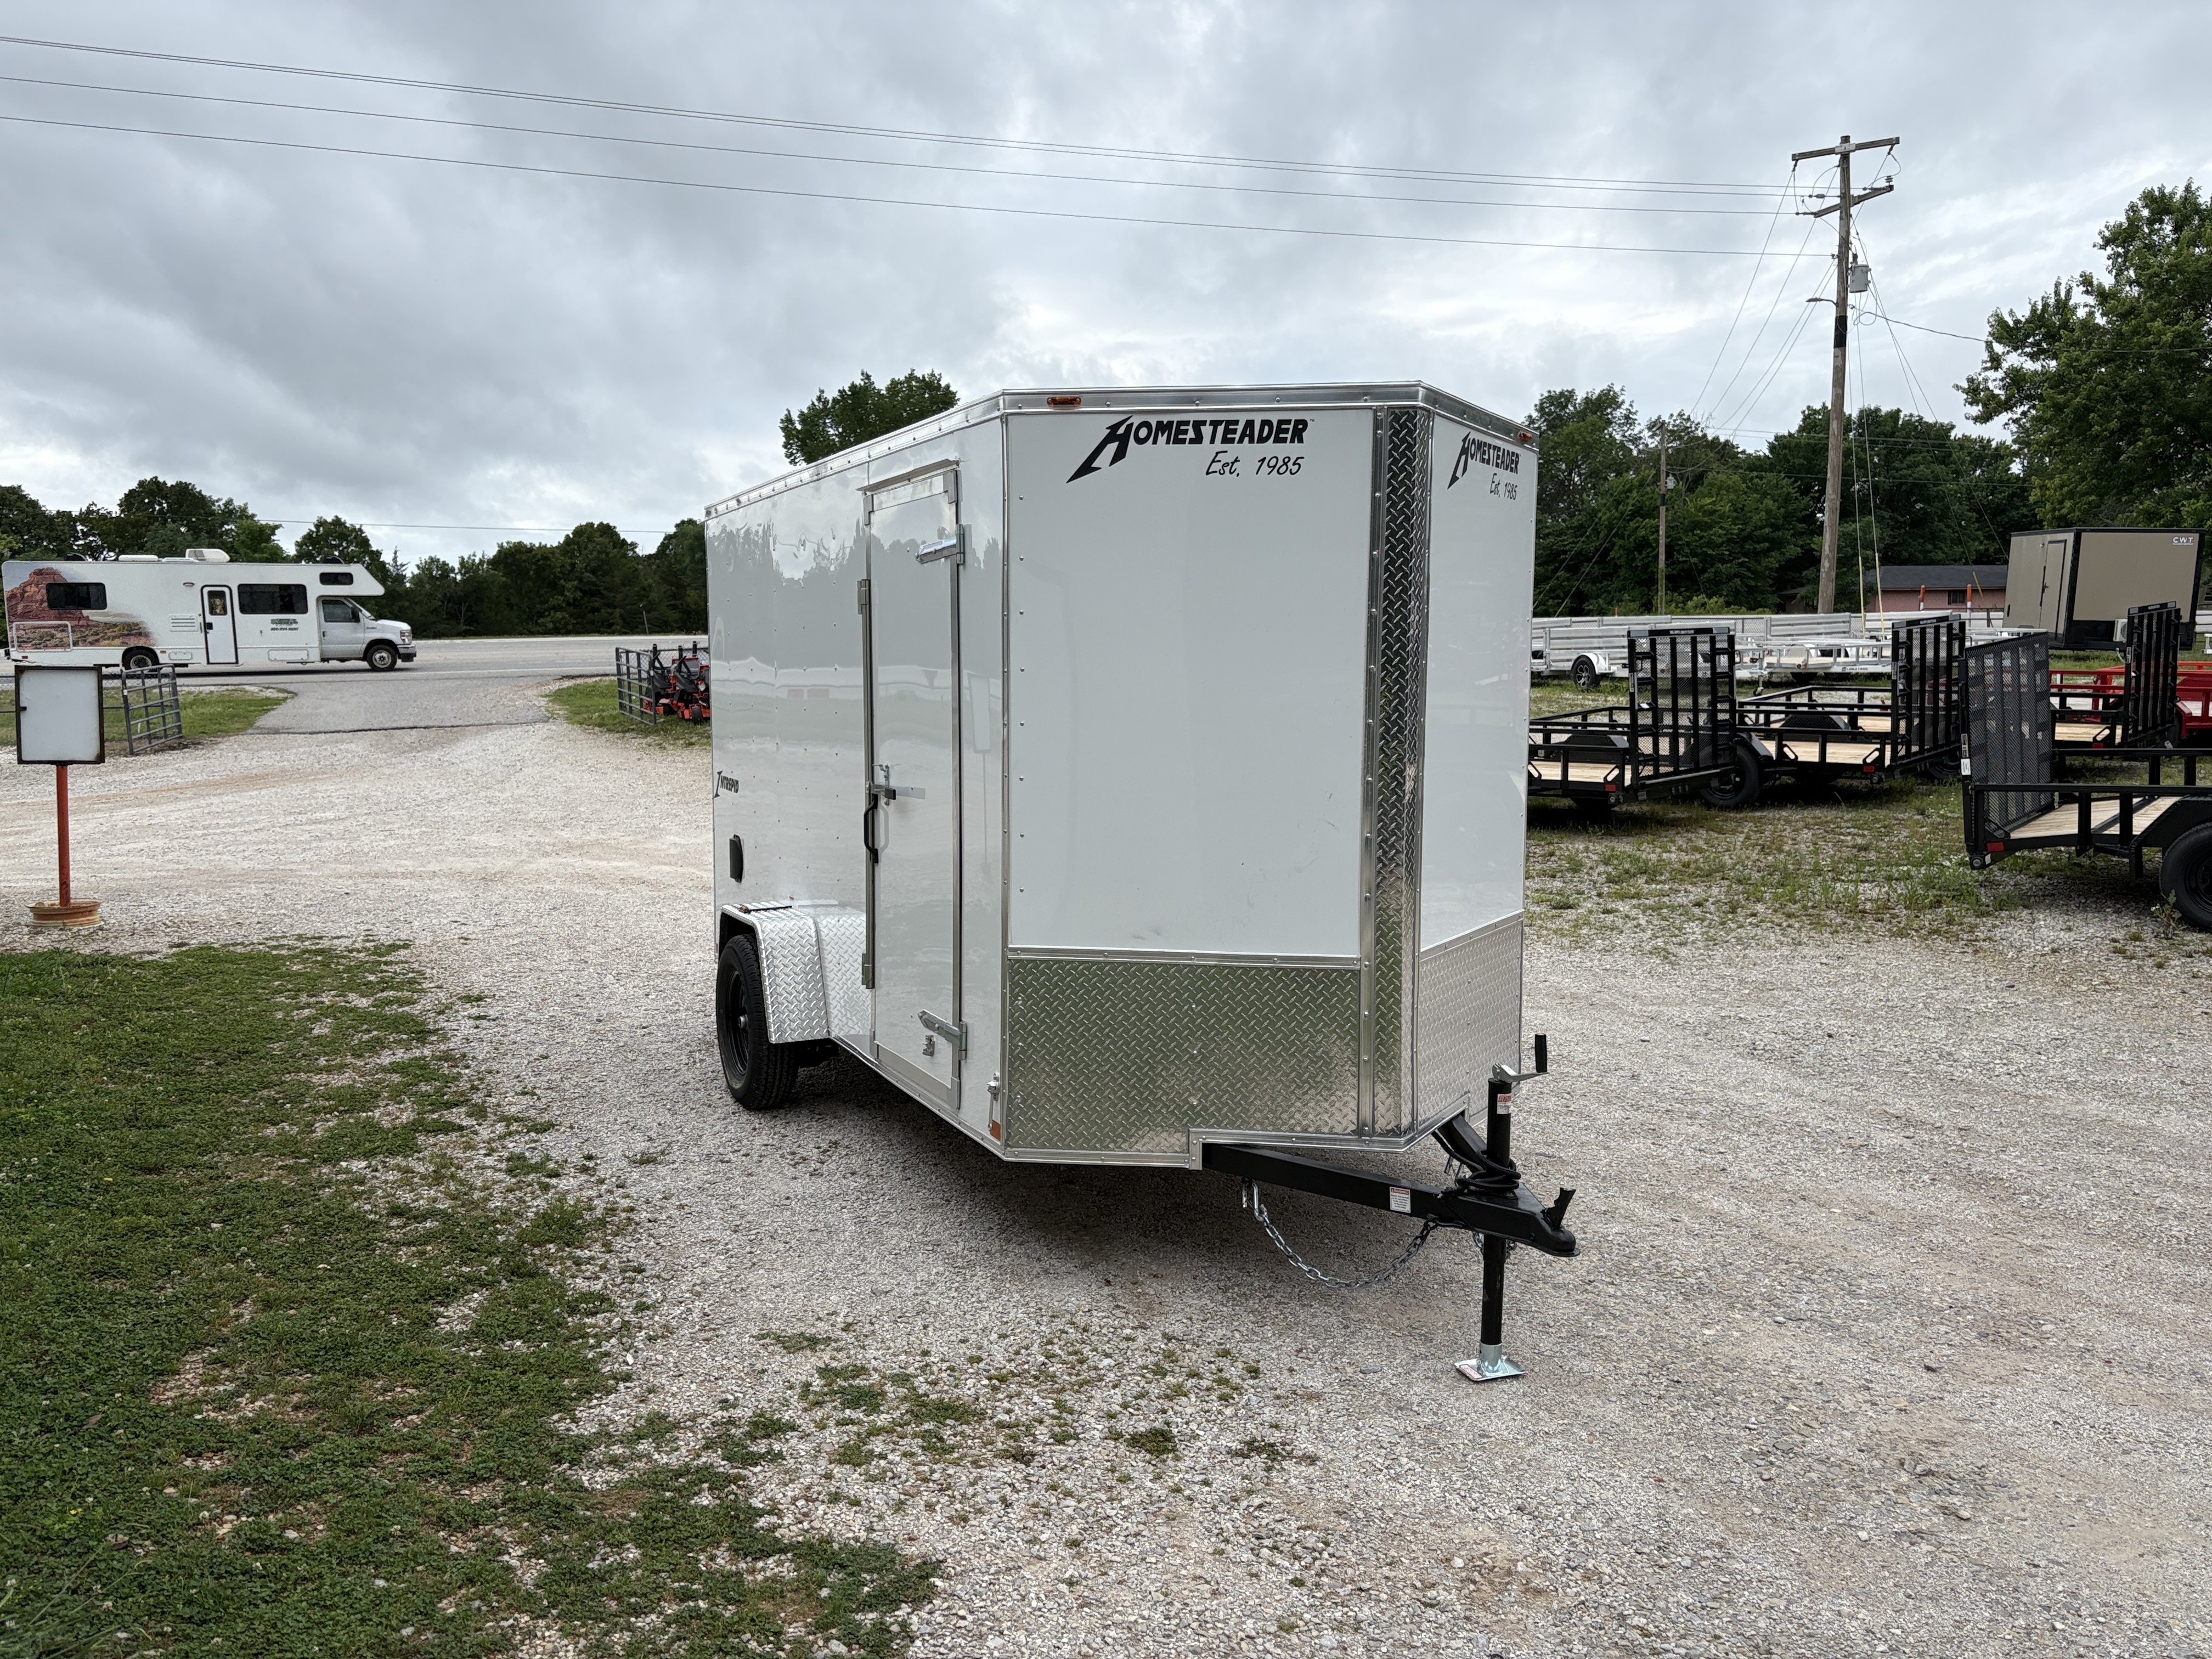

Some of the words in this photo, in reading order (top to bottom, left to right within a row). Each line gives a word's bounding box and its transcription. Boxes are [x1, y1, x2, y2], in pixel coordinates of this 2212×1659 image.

[1206, 450, 1240, 477] Est.
[1255, 455, 1305, 476] 1985
[1447, 431, 1520, 490] HOMESTEADER
[1489, 473, 1500, 498] Est.
[1504, 482, 1518, 501] 1985
[714, 770, 739, 798] INTREPID
